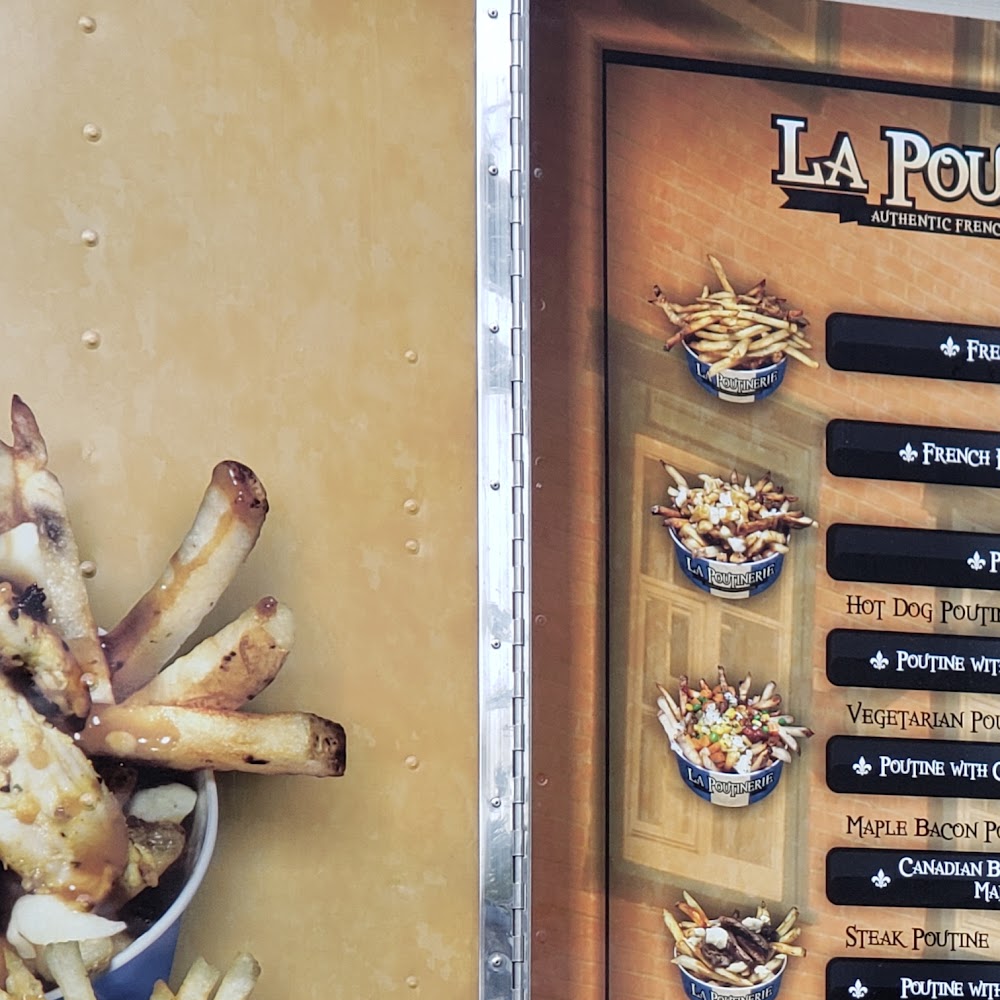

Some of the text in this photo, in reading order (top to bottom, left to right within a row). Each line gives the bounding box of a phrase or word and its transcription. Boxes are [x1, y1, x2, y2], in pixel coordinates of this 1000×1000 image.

[773, 115, 868, 190] LA
[871, 210, 951, 232] AUTHENTIC
[922, 443, 990, 468] FRENCH
[846, 595, 885, 620] HOT
[893, 597, 933, 622] DOG
[896, 650, 965, 674] POUTINE
[847, 702, 964, 730] VEGETARIAN
[879, 756, 945, 779] POUTINE
[950, 760, 988, 781] WITH
[845, 815, 908, 838] MAPLE
[914, 818, 978, 840] BACON
[899, 857, 983, 877] CANADIAN
[845, 925, 990, 952] STEAK POUTINE
[900, 977, 963, 999] POUTINE
